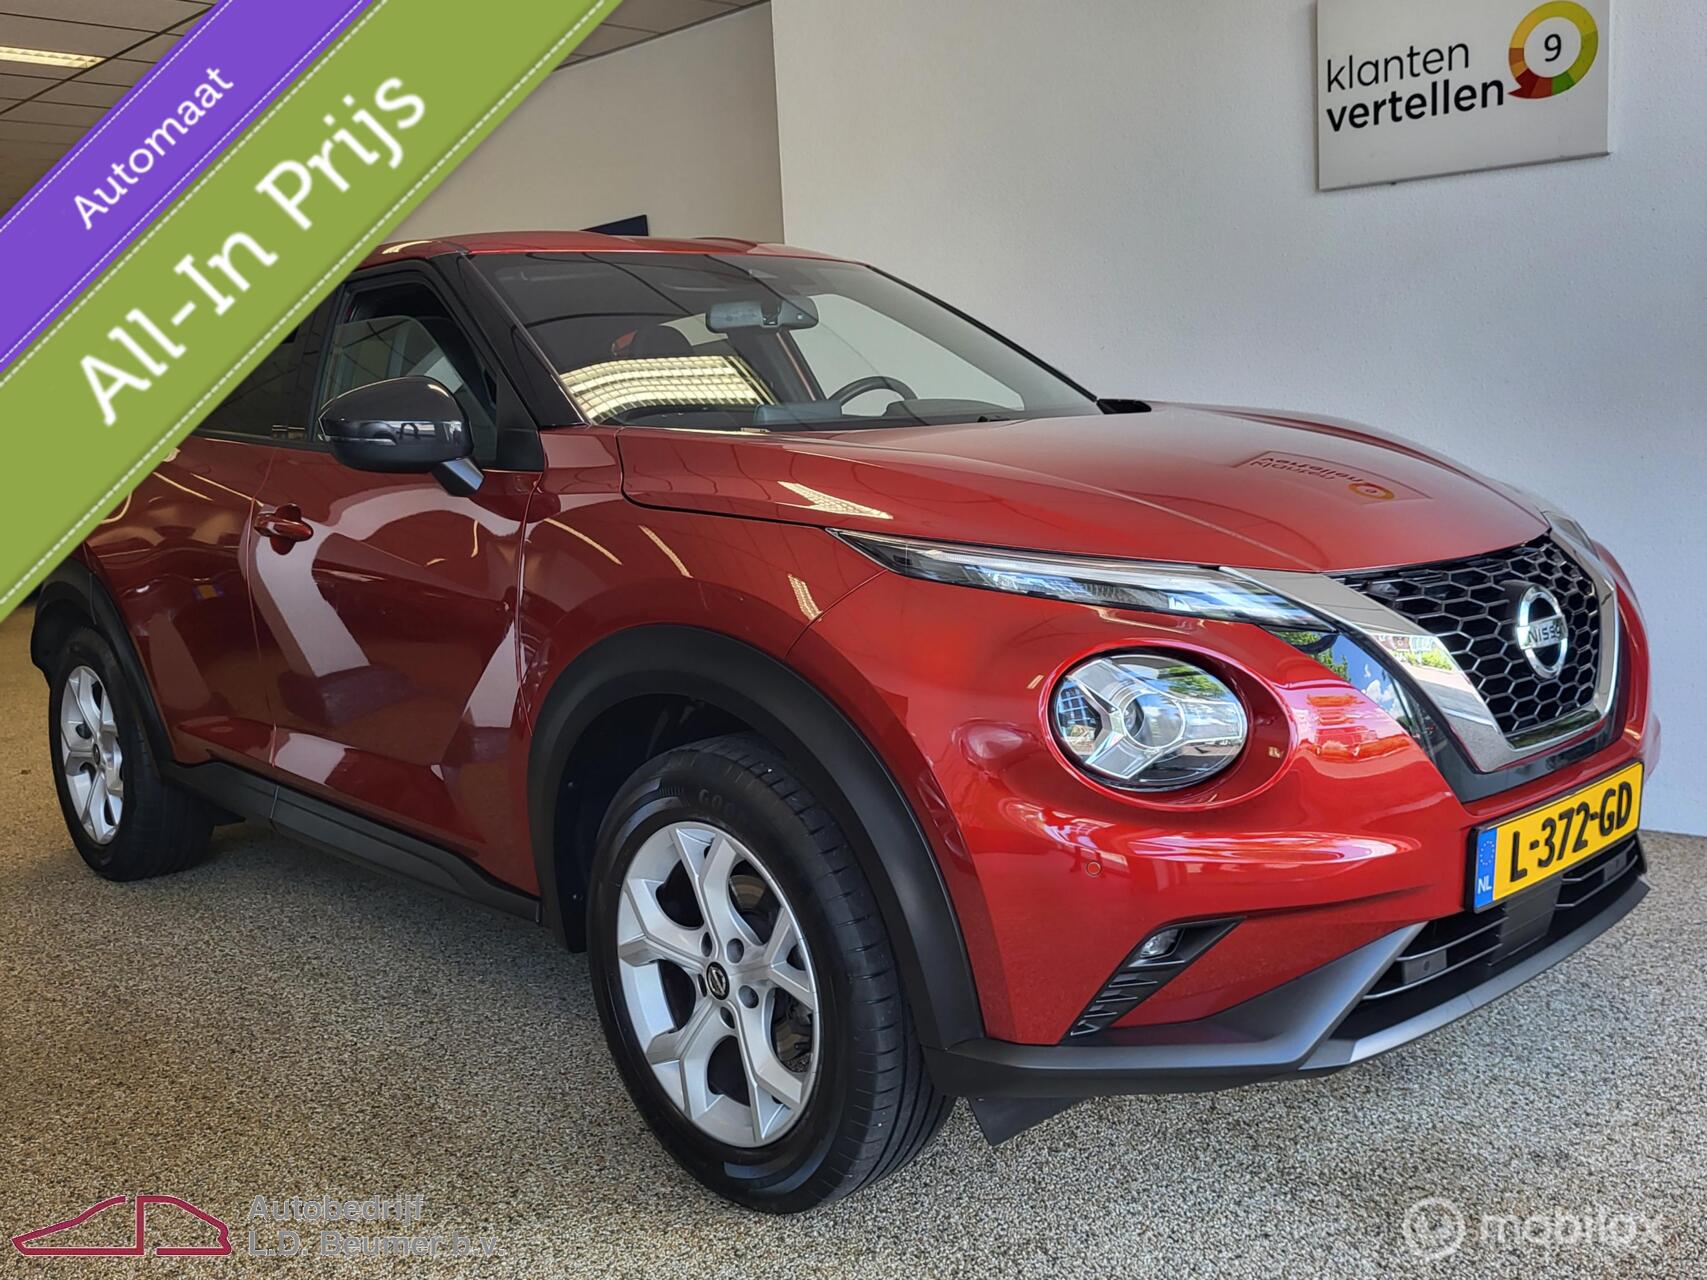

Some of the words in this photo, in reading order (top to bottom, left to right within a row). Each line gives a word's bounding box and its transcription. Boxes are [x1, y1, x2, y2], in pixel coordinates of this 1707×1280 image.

[1327, 43, 1469, 92] klanten
[1544, 34, 1562, 62] 9
[1326, 79, 1504, 132] vertellen
[1510, 781, 1632, 882] L-372-GD
[1477, 876, 1492, 894] NL
